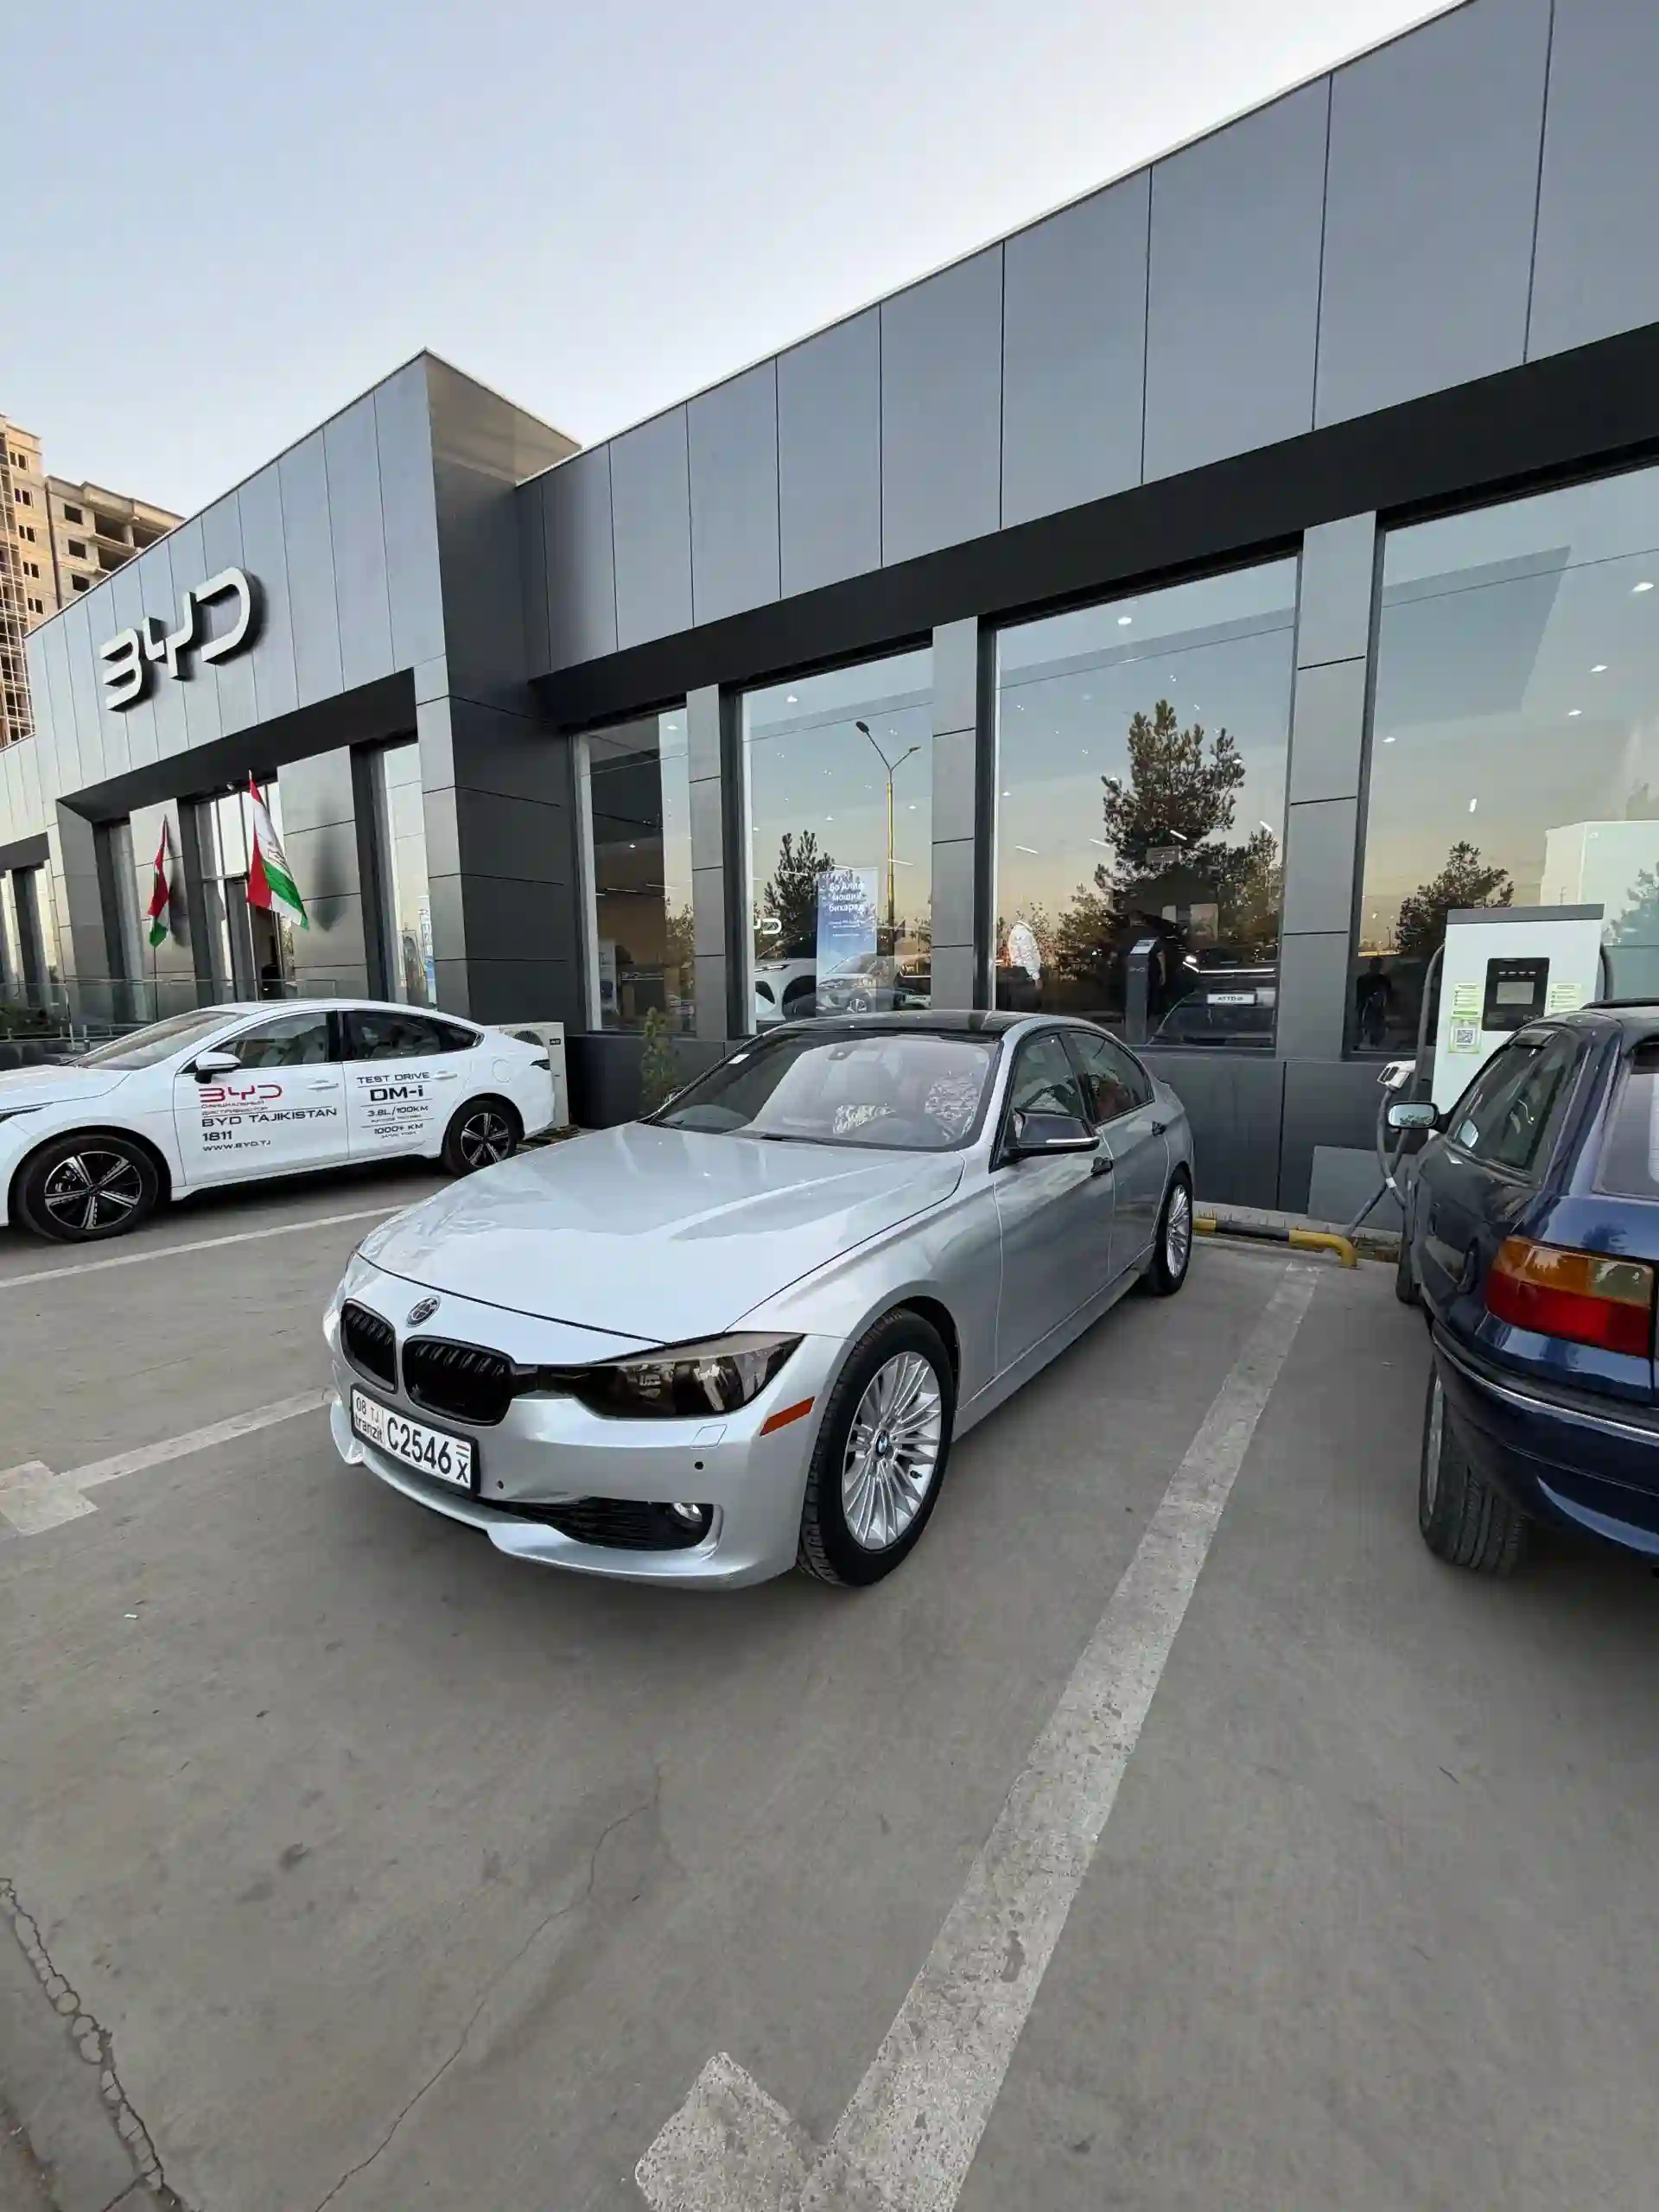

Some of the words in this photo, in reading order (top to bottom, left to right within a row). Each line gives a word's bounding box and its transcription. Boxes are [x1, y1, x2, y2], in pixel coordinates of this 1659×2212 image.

[99, 566, 252, 711] BYD
[356, 1075, 391, 1084] TEST
[394, 1071, 430, 1082] DRIVE
[198, 1084, 283, 1103] BYD
[370, 1084, 423, 1102] DM-i
[201, 1116, 242, 1128] BYD
[248, 1108, 338, 1124] TAJIKISTAN
[202, 1130, 232, 1141] 1811
[374, 1125, 404, 1135] 1000+
[408, 1122, 423, 1131] KM
[356, 1396, 366, 1415] 08
[370, 1406, 379, 1422] TJ
[355, 1413, 383, 1443] tranzit
[387, 1417, 452, 1475] C2546
[456, 1459, 468, 1484] X
